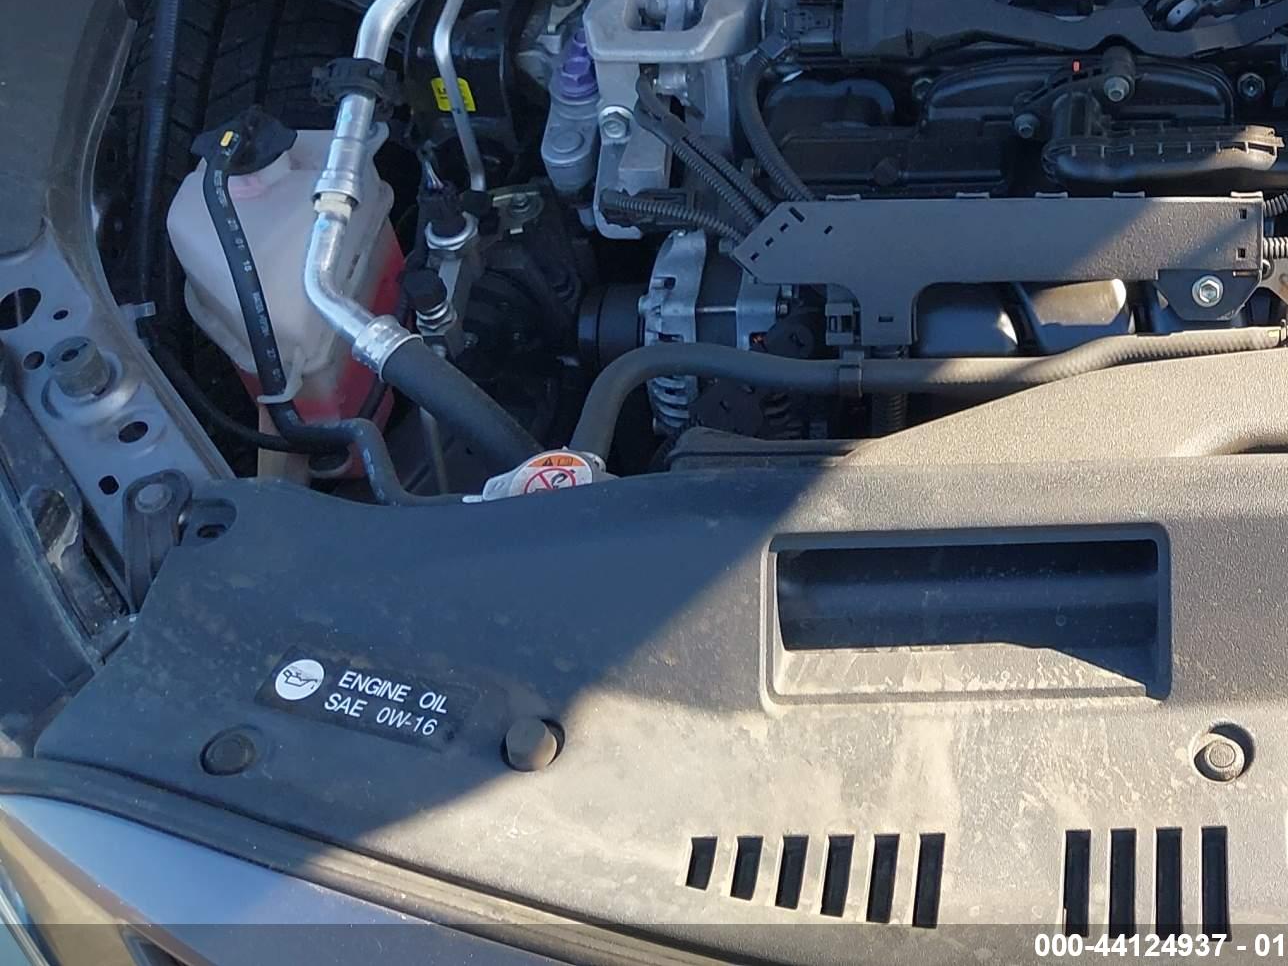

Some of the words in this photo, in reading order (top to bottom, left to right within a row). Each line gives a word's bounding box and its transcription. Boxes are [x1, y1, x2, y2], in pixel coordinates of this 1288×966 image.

[323, 691, 369, 718] SAE
[375, 705, 438, 736] 0W-16
[338, 669, 412, 703] ENGINE
[418, 690, 450, 715] OIL
